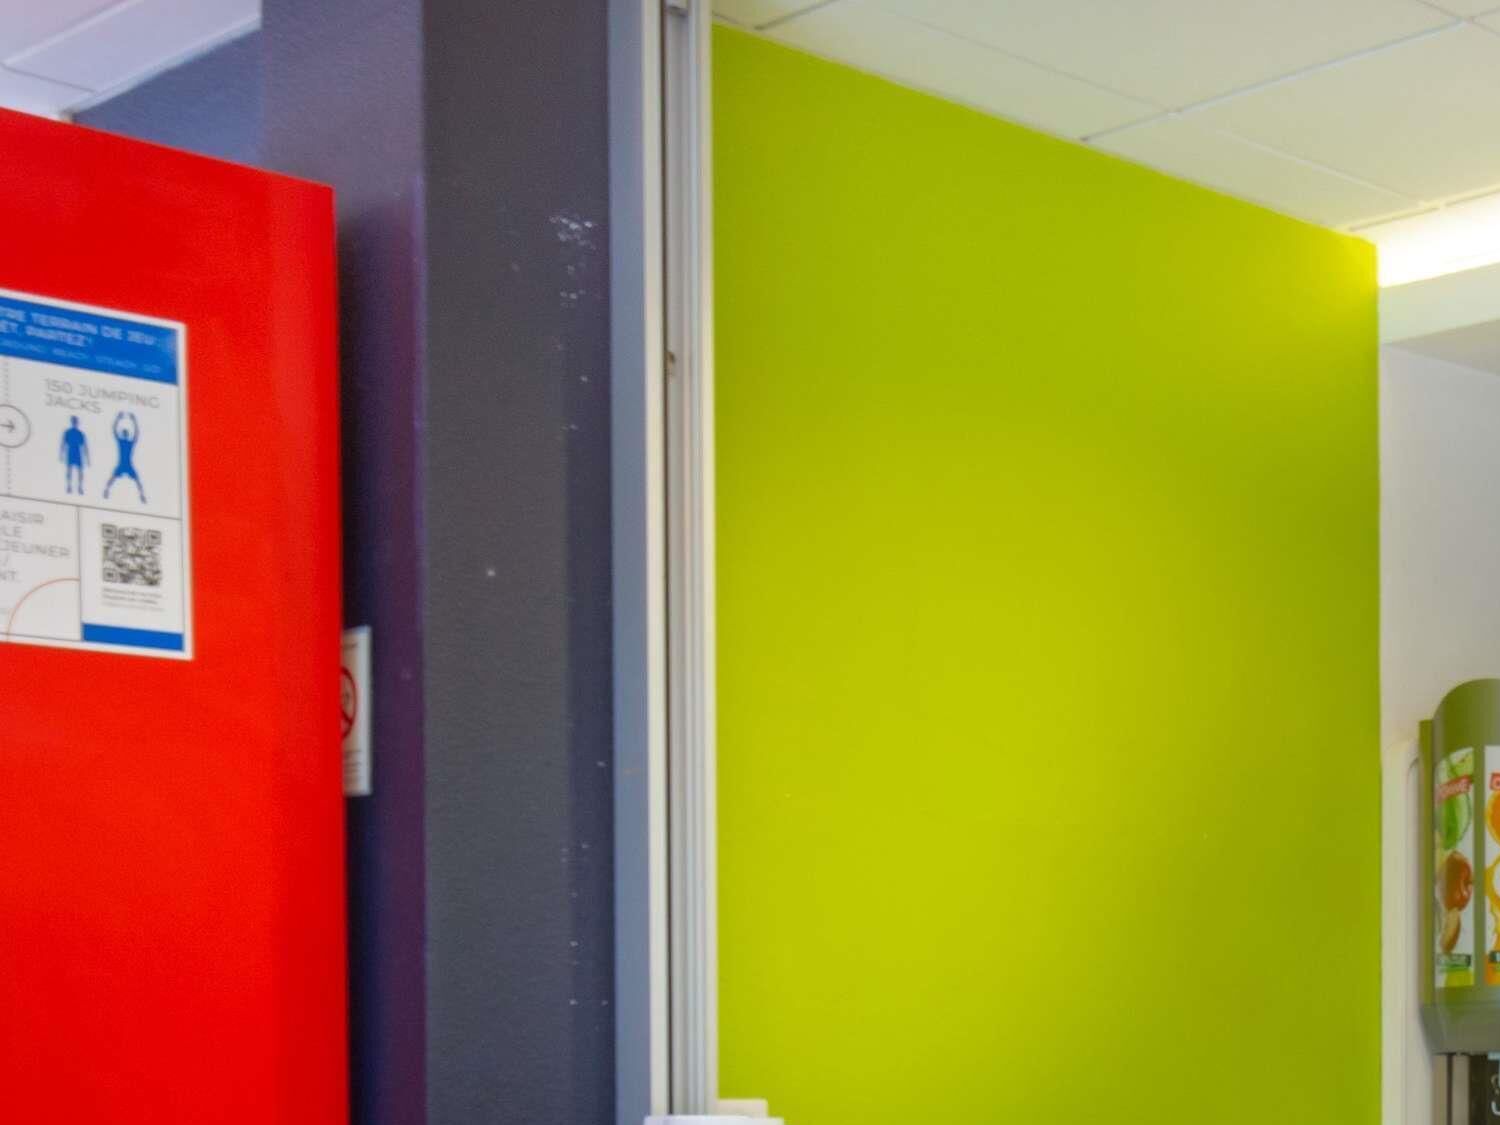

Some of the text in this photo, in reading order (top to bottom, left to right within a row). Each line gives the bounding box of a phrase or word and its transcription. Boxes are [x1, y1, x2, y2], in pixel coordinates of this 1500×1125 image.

[45, 378, 161, 409] 150 JUMPING
[45, 393, 102, 414] JACKS
